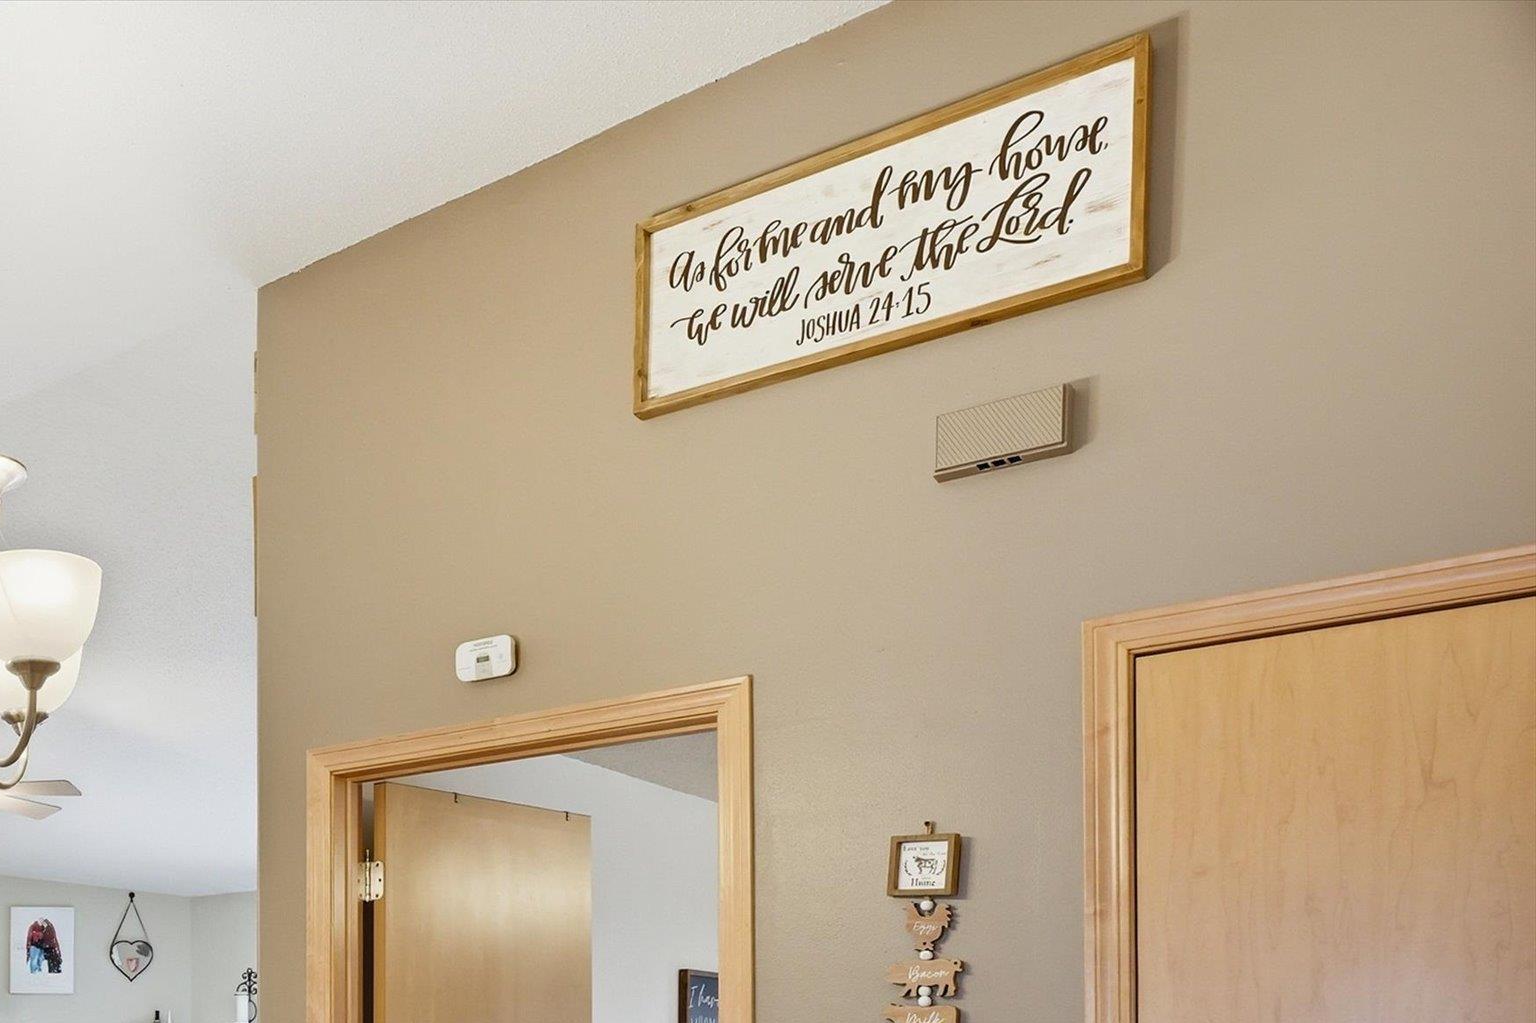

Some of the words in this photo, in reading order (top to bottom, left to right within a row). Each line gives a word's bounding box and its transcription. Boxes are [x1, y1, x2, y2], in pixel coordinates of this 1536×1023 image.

[669, 250, 706, 292] As
[709, 226, 753, 292] for
[753, 219, 808, 264] me
[810, 165, 893, 246] and
[888, 162, 983, 212] my
[731, 266, 801, 329] will
[804, 244, 898, 309] serve
[898, 215, 980, 282] the
[796, 303, 861, 346] JOSHUA
[908, 965, 950, 983] Bacon
